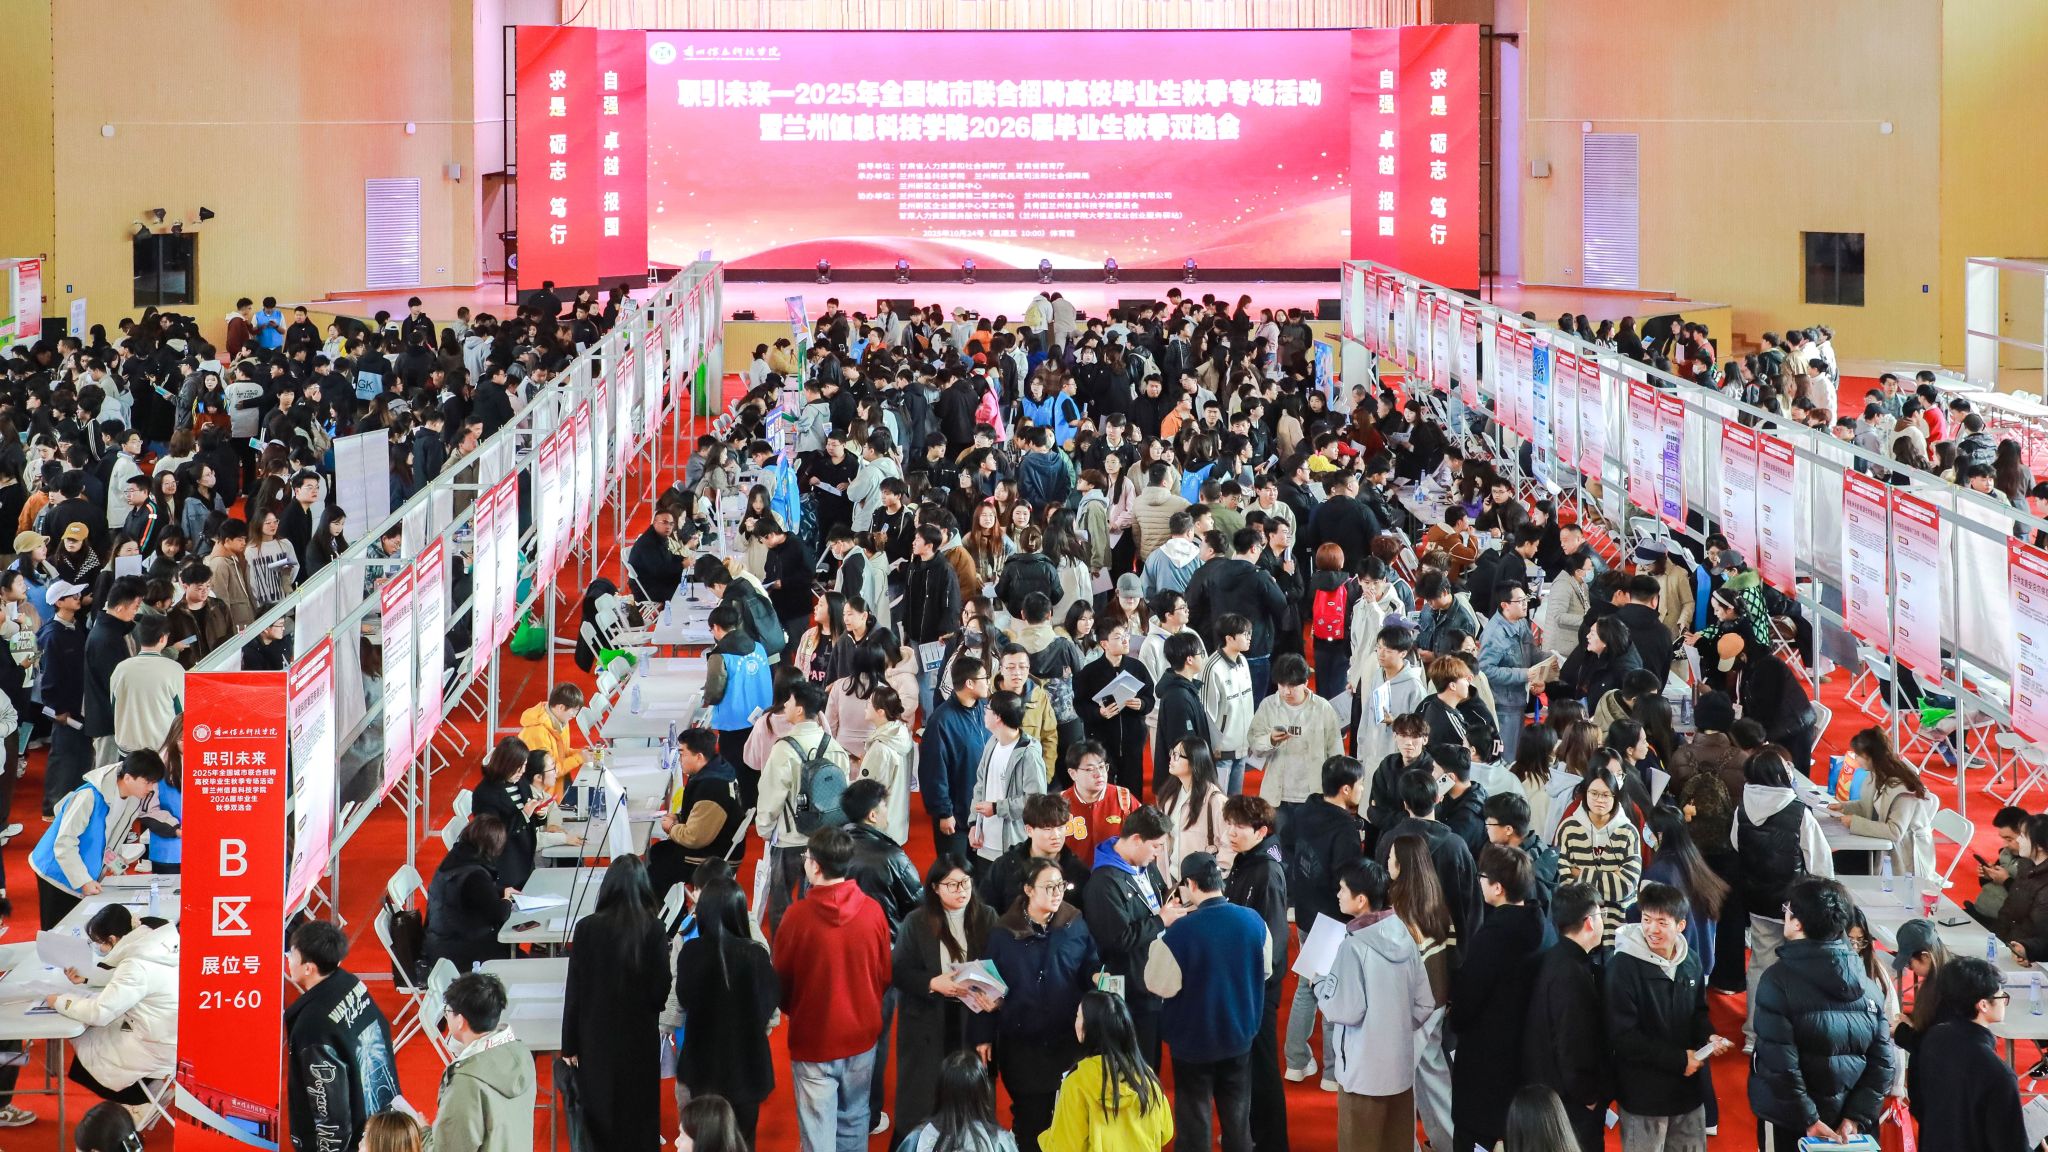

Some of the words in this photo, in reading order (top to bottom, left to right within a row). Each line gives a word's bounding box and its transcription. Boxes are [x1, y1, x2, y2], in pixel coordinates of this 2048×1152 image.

[549, 70, 567, 117] 求是
[603, 70, 619, 115] 自强
[1379, 69, 1395, 114] 自强
[1430, 68, 1447, 116] 求是
[760, 113, 1240, 141] 暨兰州信息科技学院2026届毕业生秋季双选会
[603, 131, 619, 176] 卓越
[1379, 130, 1395, 175] 卓越
[604, 192, 620, 237] 报国
[1379, 191, 1395, 236] 报国
[192, 769, 276, 777] 2025年全国城市联合招聘
[203, 750, 266, 766] 职引未来
[194, 777, 274, 785] 高校毕业生秋季专场活动
[210, 795, 257, 803] 2026届毕业生
[216, 804, 252, 812] 秋季双选会
[219, 838, 247, 877] B
[211, 896, 252, 937] 区
[201, 955, 261, 976] 展位号
[198, 989, 262, 1010] 21-60
